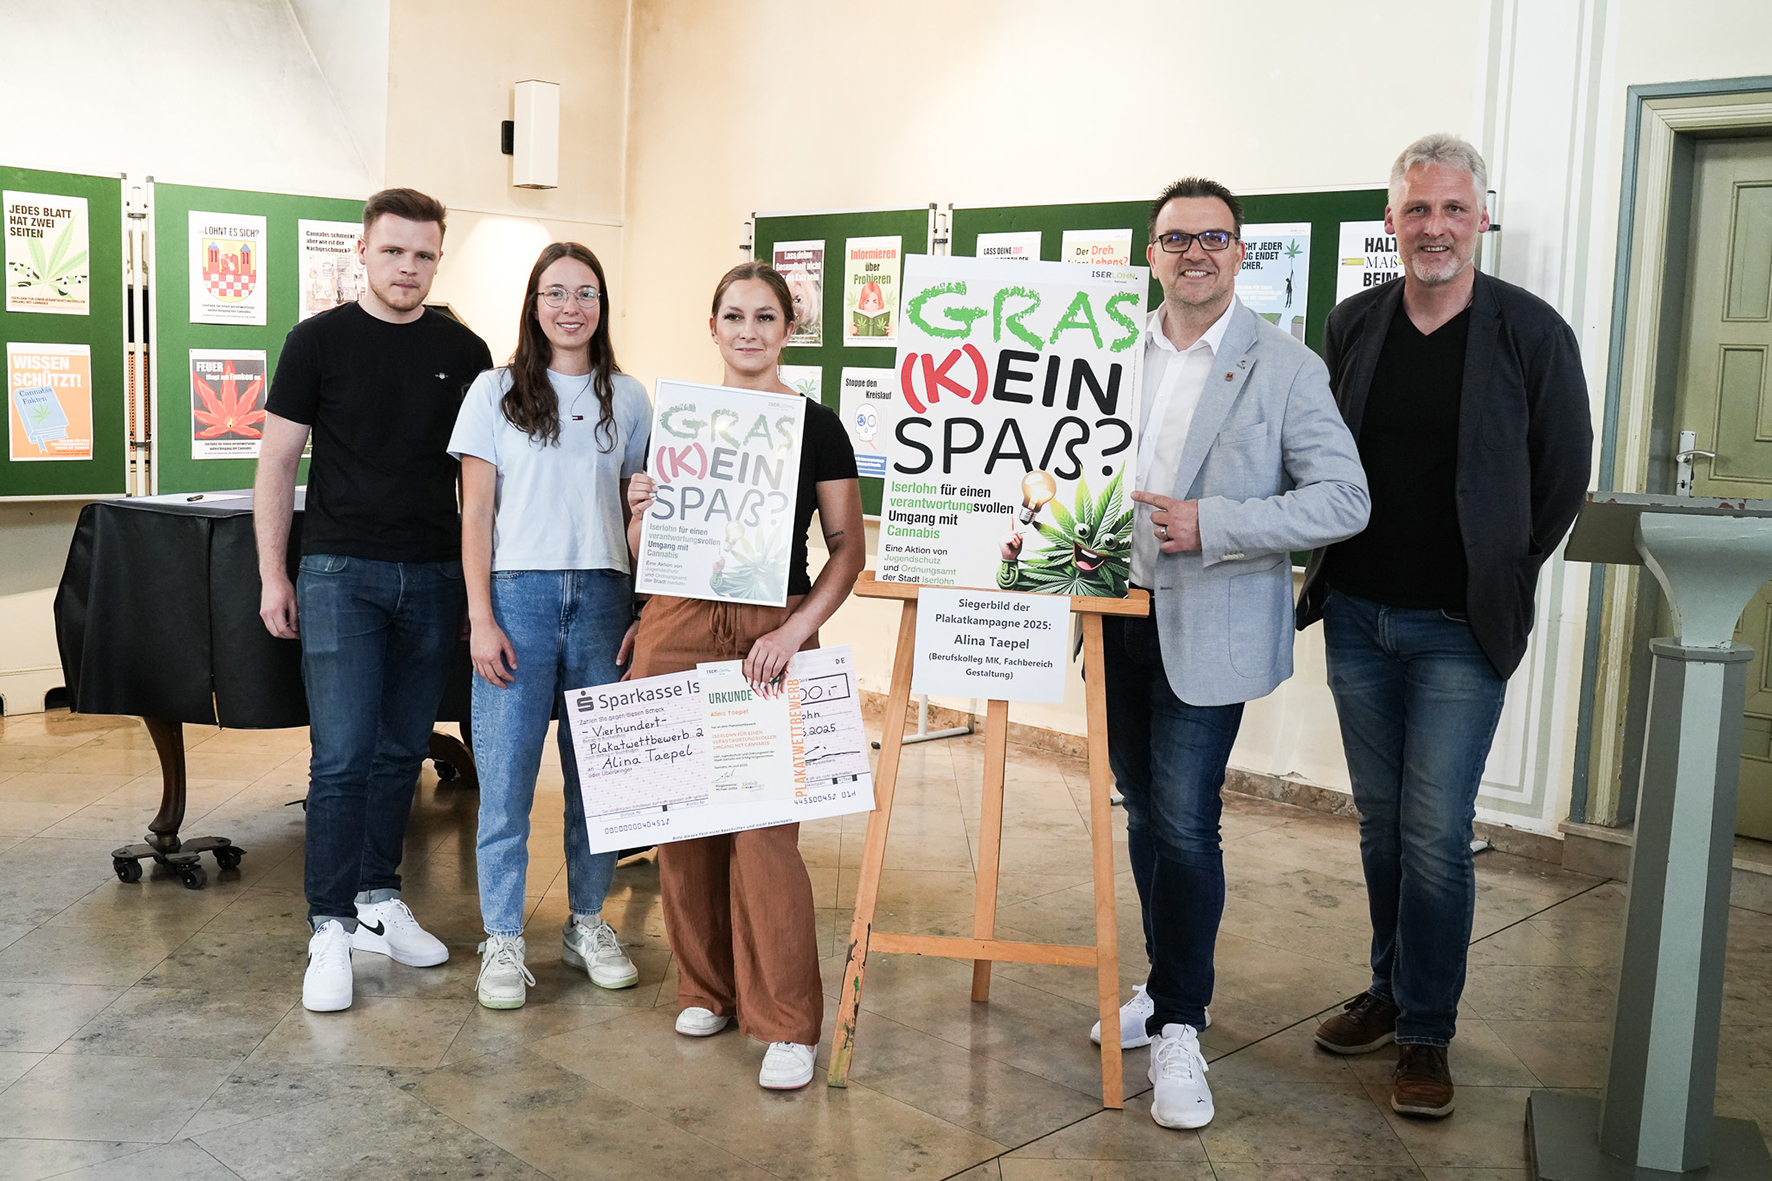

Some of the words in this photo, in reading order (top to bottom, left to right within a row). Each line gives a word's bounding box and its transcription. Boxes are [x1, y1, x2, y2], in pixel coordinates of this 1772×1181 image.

[9, 204, 40, 216] JEDES
[43, 207, 72, 219] BLATT
[9, 215, 28, 226] HAT
[31, 217, 55, 228] ZWEI
[10, 226, 44, 238] SEITEN
[229, 227, 238, 237] ES
[239, 228, 260, 238] SICH?
[983, 247, 996, 256] LASS
[997, 246, 1012, 255] DEINE
[1012, 246, 1023, 255] ZEIT
[1076, 247, 1090, 256] Der
[1091, 244, 1114, 255] Dreh
[1258, 242, 1283, 251] JEDER
[1364, 237, 1398, 253] HALT
[850, 248, 896, 260] Informieren
[1255, 252, 1279, 260] ENDET
[865, 262, 880, 271] über
[853, 274, 892, 285] Probieren
[905, 281, 1140, 353] GRAS
[12, 355, 70, 370] WISSEN
[196, 361, 224, 372] FEUER
[12, 370, 82, 388] SCHÜTZT!
[845, 378, 866, 388] Stoppe
[866, 379, 877, 388] den
[900, 343, 1123, 415] (K)EIN
[19, 386, 53, 397] Cannabis
[865, 391, 892, 400] Kreislauf
[22, 396, 48, 405] Fakten
[659, 403, 796, 452] GRAS
[893, 416, 1133, 480] SPAß?
[656, 441, 785, 490] (K)EIN
[891, 481, 937, 495] Iserlohn
[940, 483, 957, 496] für
[960, 485, 991, 498] einen
[651, 484, 789, 528] SPAß?
[890, 498, 1014, 515] verantwortungsvollen
[888, 510, 935, 526] Umgang
[939, 513, 958, 526] mit
[649, 523, 677, 533] Iserlohn
[689, 528, 708, 536] einen
[887, 525, 940, 539] Cannabis
[648, 533, 721, 546] verantwortungsvollen
[648, 540, 676, 552] Umgang
[647, 549, 679, 559] Cannabis
[885, 544, 903, 554] Eine
[904, 545, 931, 555] Aktion
[932, 548, 948, 556] von
[884, 554, 941, 565] Jugendschutz
[645, 566, 679, 574] Jugendschutz
[883, 564, 899, 572] und
[901, 565, 957, 576] Ordnungsamt
[882, 573, 896, 581] der
[898, 574, 920, 583] Stadt
[922, 576, 954, 585] Iserlohn
[958, 598, 1010, 611] Siegerbild
[1013, 602, 1031, 612] der
[935, 613, 1021, 630] Plakatkampagne
[1023, 619, 1052, 630] 2025:
[953, 634, 986, 647] Alina
[989, 636, 1030, 651] Taepel
[835, 657, 845, 665] DE
[928, 652, 983, 665] (Berufskolleg
[985, 656, 1002, 665] MK,
[1004, 657, 1053, 668] Fachbereich
[965, 668, 1014, 680] Gestaltung)
[598, 685, 683, 711] Sparkasse
[708, 689, 753, 705] URKUNDE
[579, 717, 598, 726] Zahlen
[608, 713, 626, 722] gegen
[626, 710, 645, 718] diesen
[645, 706, 665, 714] Scheck
[590, 729, 690, 755] Plakatwettbewerb
[787, 678, 808, 798] PLAKATWETTBEWERB
[601, 756, 642, 770] Alina
[645, 744, 693, 764] Taepel
